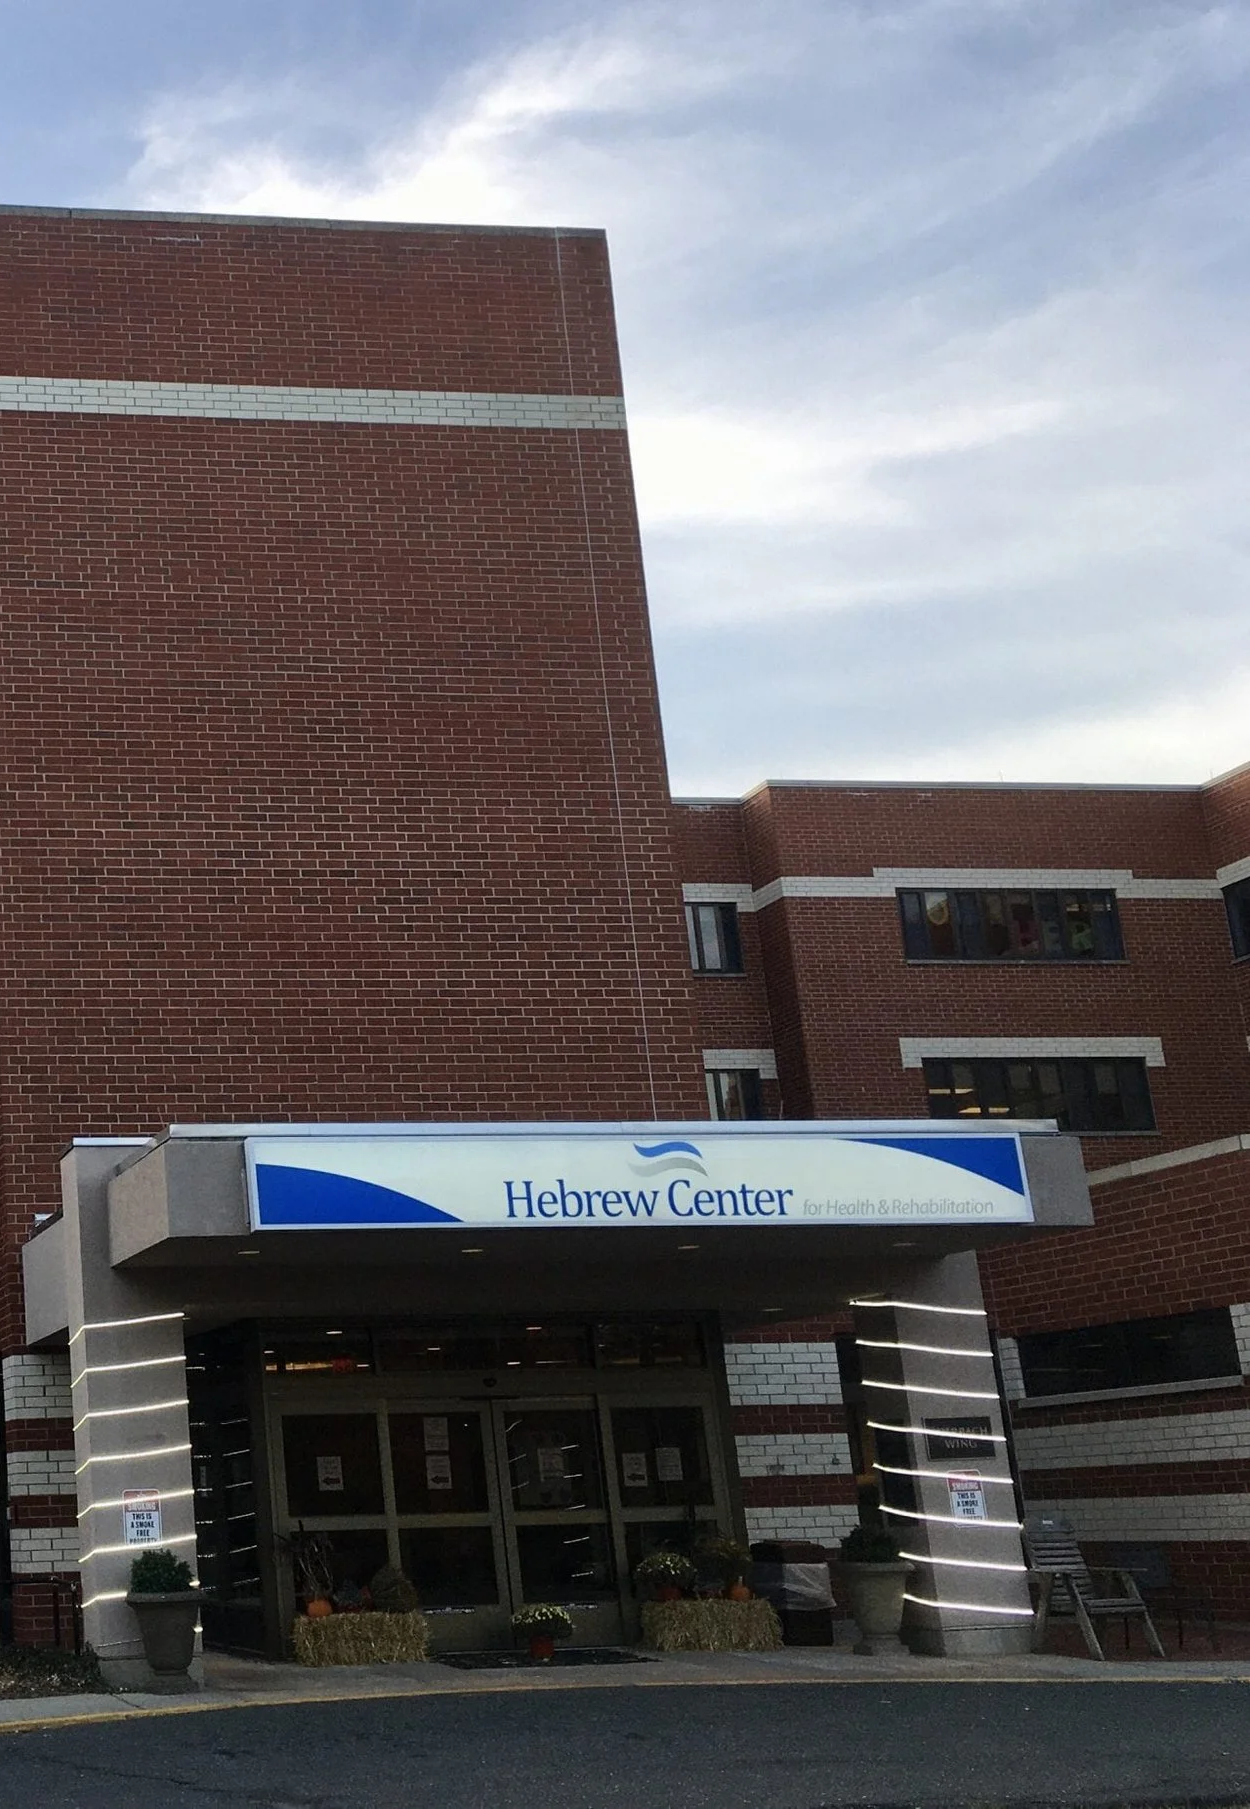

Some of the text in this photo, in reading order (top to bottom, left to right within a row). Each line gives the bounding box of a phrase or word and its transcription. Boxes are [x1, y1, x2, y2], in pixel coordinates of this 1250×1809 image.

[503, 1179, 794, 1218] Hebrew Center
[803, 1198, 994, 1216] for Health & Rehabilitation
[944, 1439, 978, 1449] WING
[136, 1529, 150, 1537] FREE
